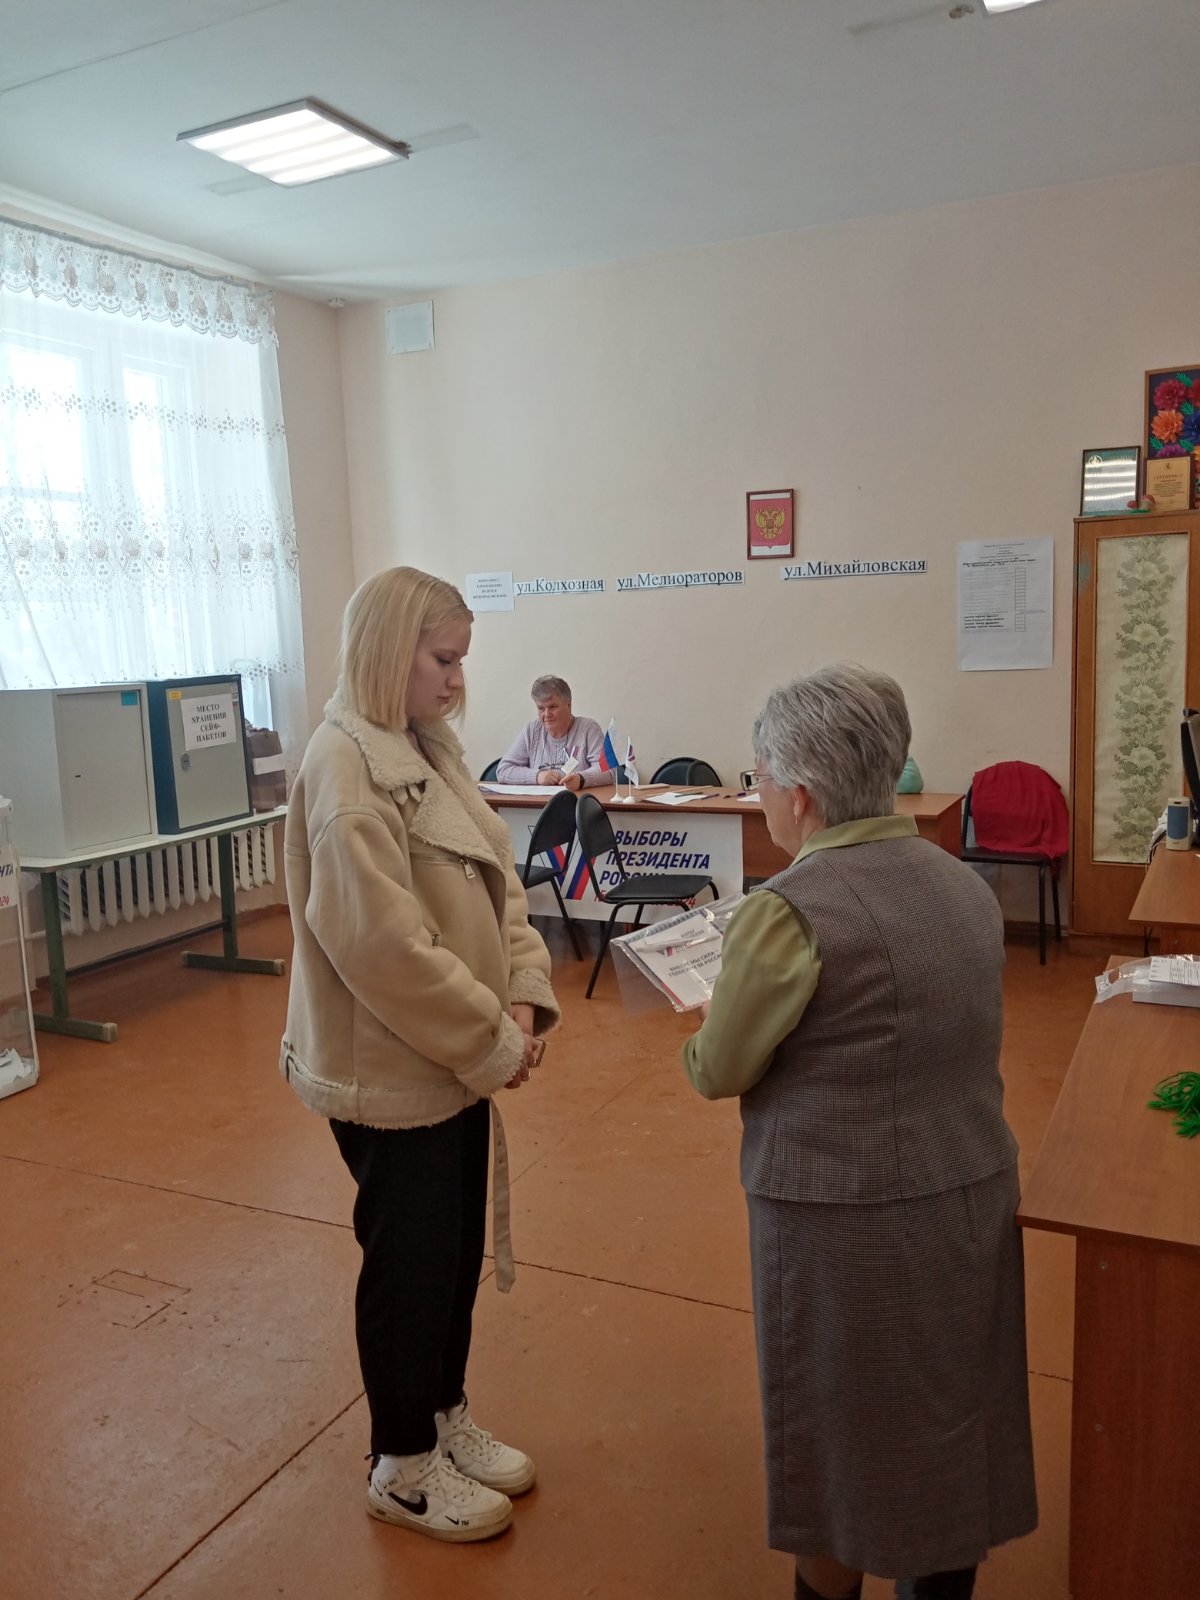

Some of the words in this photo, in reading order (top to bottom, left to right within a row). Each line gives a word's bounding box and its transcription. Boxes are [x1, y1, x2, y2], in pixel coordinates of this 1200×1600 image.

[784, 559, 926, 580] ул.Михайловская
[516, 579, 604, 595] ул.Колхозная
[617, 571, 743, 591] ул.Мелиораторов
[196, 704, 220, 712] МЕСТО
[191, 712, 227, 724] ХРАНЕНИЯ
[200, 723, 221, 732] СЕЙФ-
[196, 731, 227, 743] ПАКЕТОВ
[615, 830, 688, 847] ВЫБОРЫ
[606, 851, 710, 870] ПРЕЗИДЕНТА
